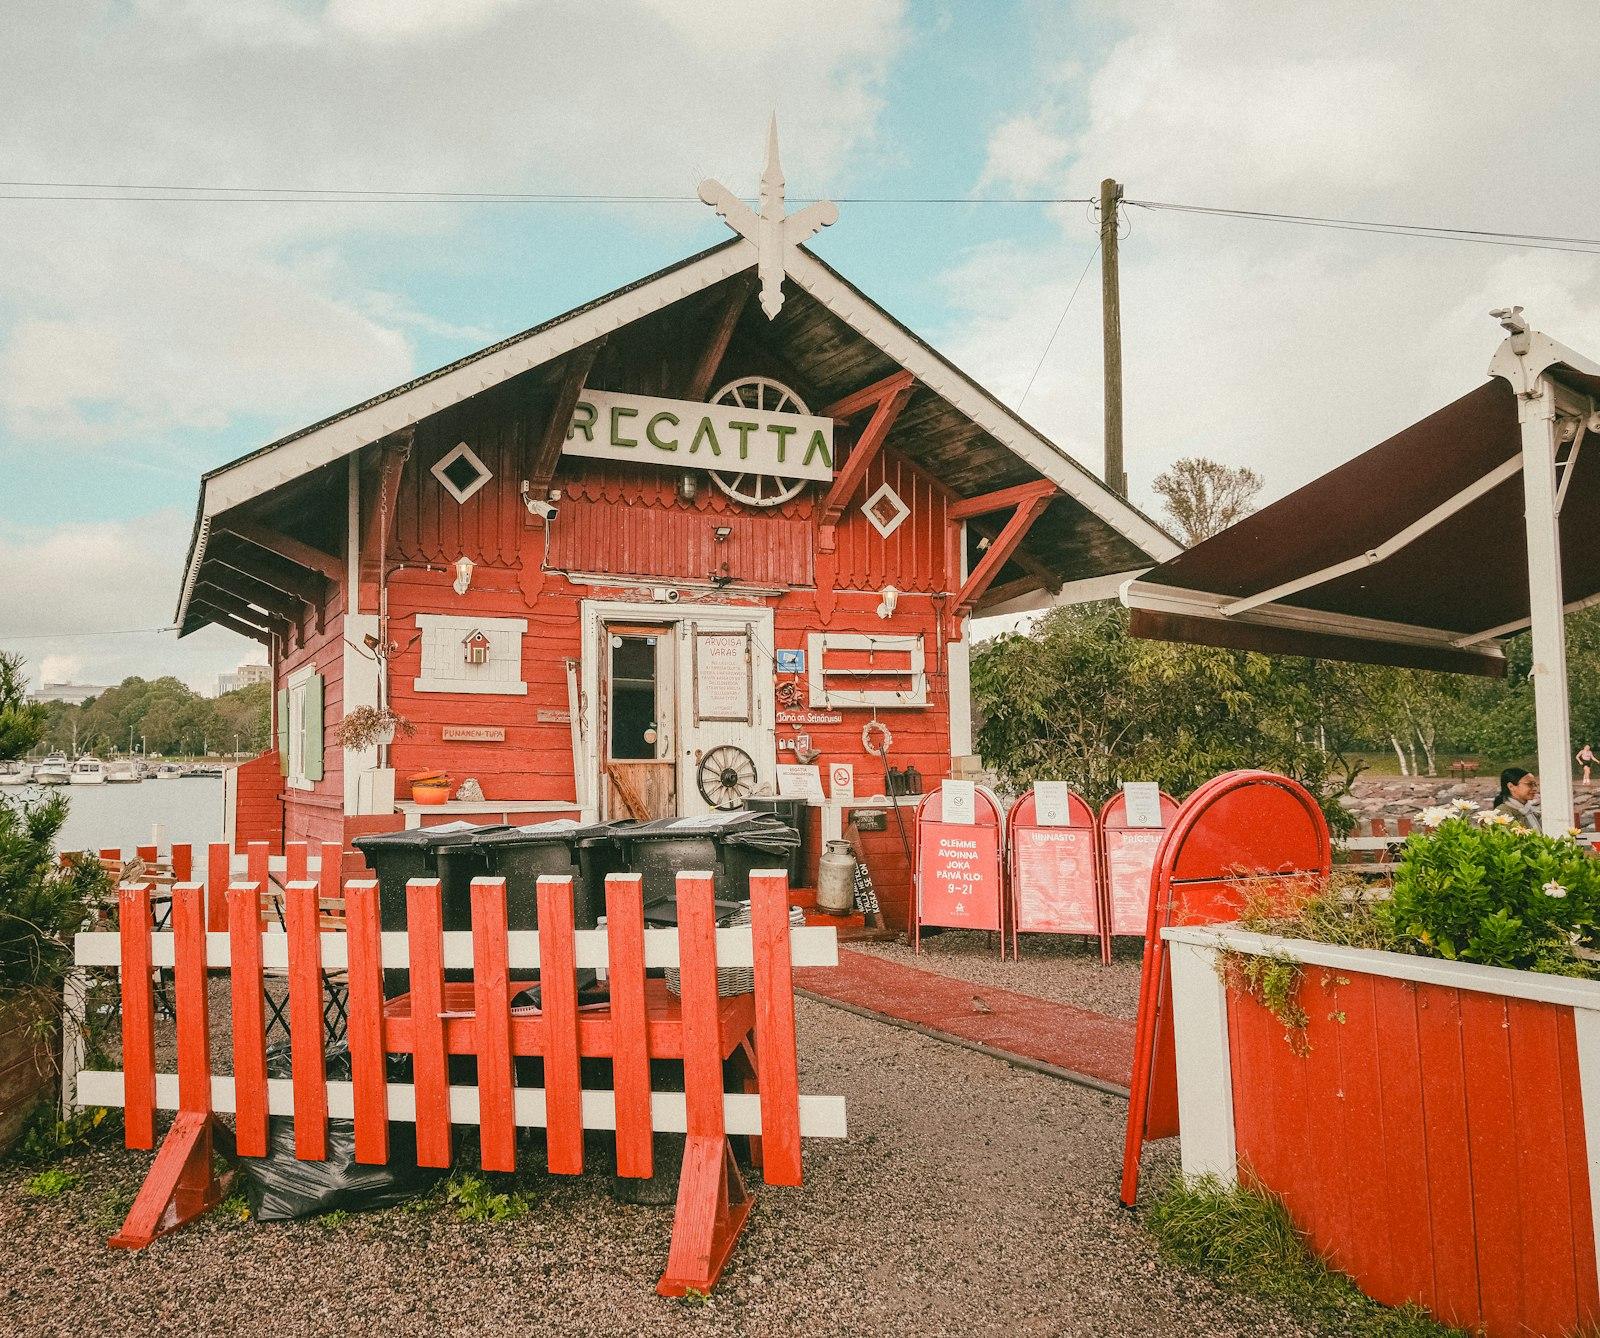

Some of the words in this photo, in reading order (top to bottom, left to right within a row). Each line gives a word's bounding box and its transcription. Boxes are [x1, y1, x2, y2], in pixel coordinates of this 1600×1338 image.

[566, 401, 832, 468] REGATTA
[704, 637, 742, 647] ARVOISA
[710, 648, 737, 657] VARAS
[1032, 832, 1076, 842] HINNASTO
[1123, 834, 1149, 843] PRICE
[1152, 835, 1162, 843] LI
[940, 839, 977, 848] OLEMME
[938, 849, 979, 859] AVOINNA
[859, 863, 869, 875] ON
[947, 860, 970, 869] JOKA
[936, 869, 962, 880] PÄIVÄ
[963, 872, 983, 881] KLO:
[864, 877, 873, 887] SE
[869, 890, 880, 913] KOSKA
